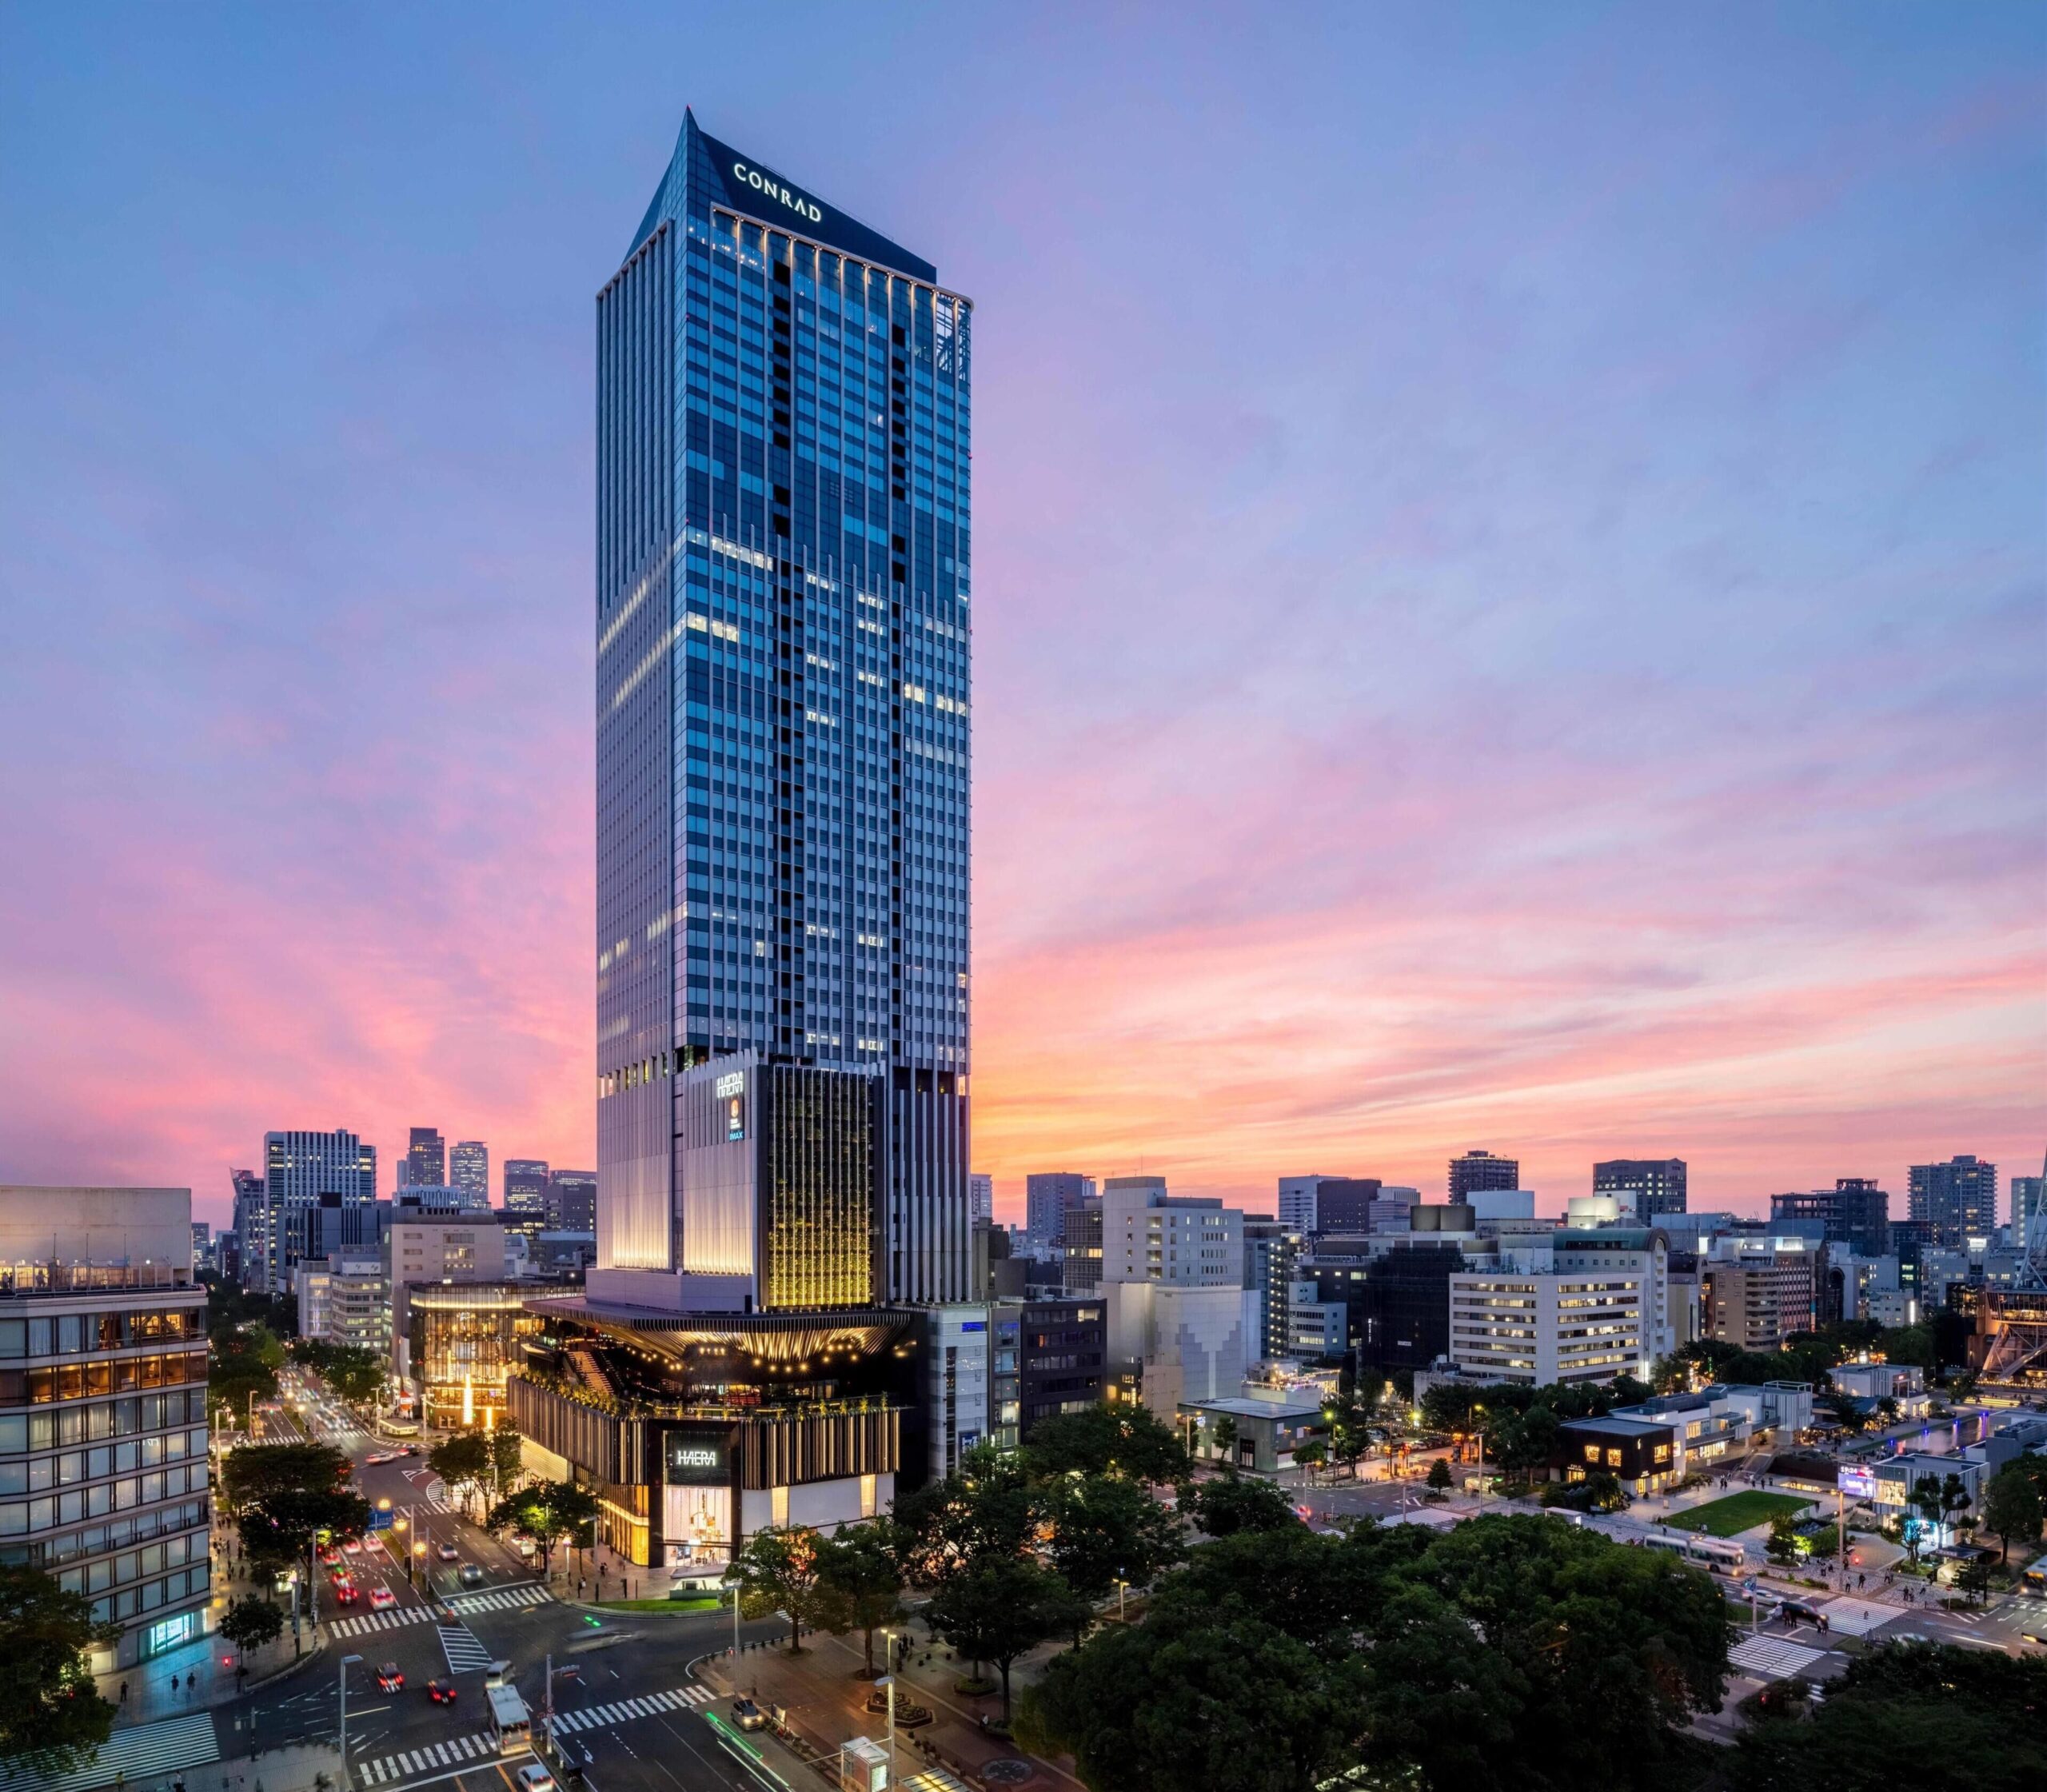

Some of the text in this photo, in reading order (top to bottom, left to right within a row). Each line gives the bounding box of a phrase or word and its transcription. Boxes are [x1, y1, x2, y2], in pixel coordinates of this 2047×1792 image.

[734, 163, 822, 222] CONRAD
[729, 1131, 744, 1140] IMAX
[677, 1450, 716, 1467] HAERA
